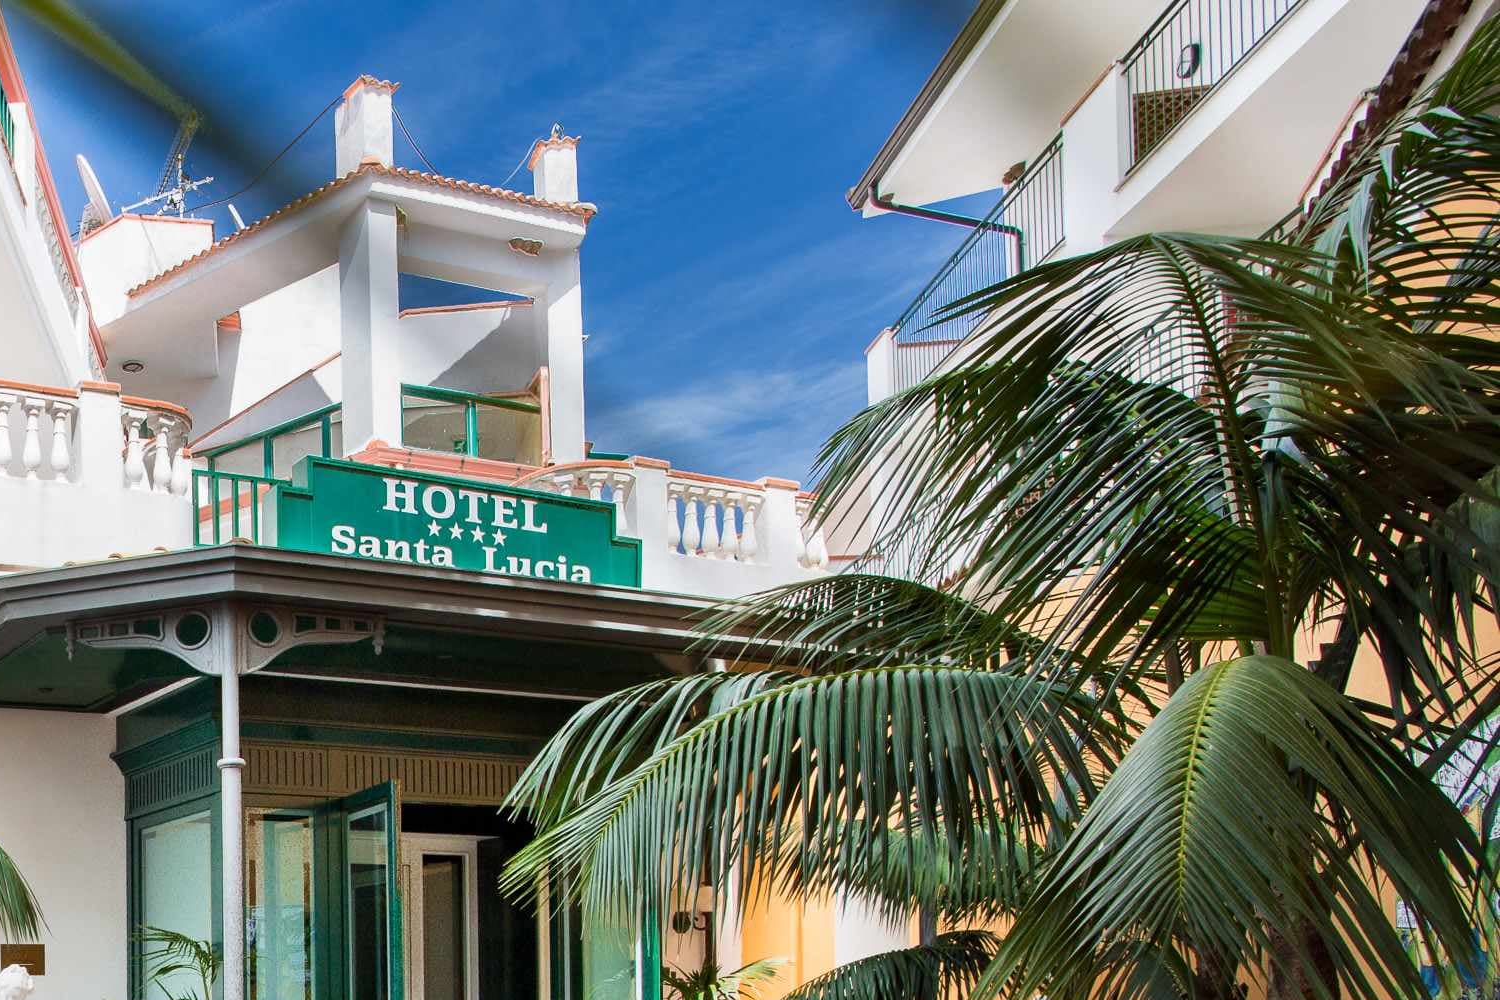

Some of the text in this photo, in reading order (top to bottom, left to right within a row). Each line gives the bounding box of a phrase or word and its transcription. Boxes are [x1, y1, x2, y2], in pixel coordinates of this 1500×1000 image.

[382, 477, 548, 534] HOTEL
[331, 525, 592, 585] Santa Lucia
